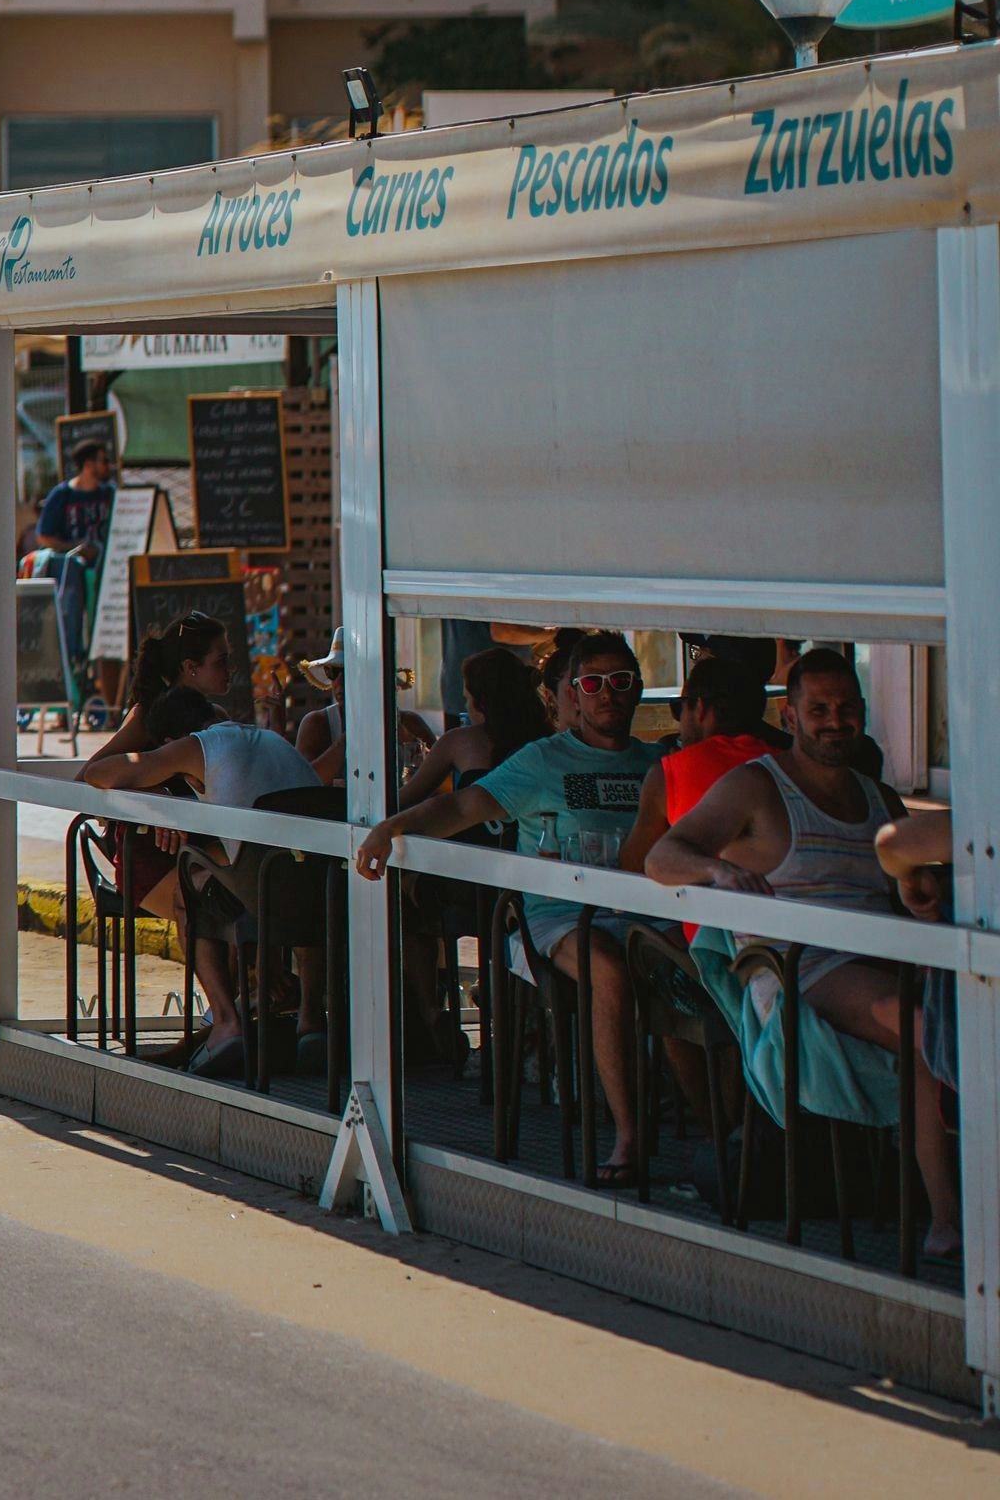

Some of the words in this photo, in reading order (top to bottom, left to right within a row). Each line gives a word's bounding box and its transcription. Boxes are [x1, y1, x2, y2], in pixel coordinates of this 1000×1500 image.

[197, 188, 300, 257] Arroces
[346, 166, 454, 237] Carnes
[507, 119, 673, 220] Pescados
[744, 79, 954, 195] Zarzuelas
